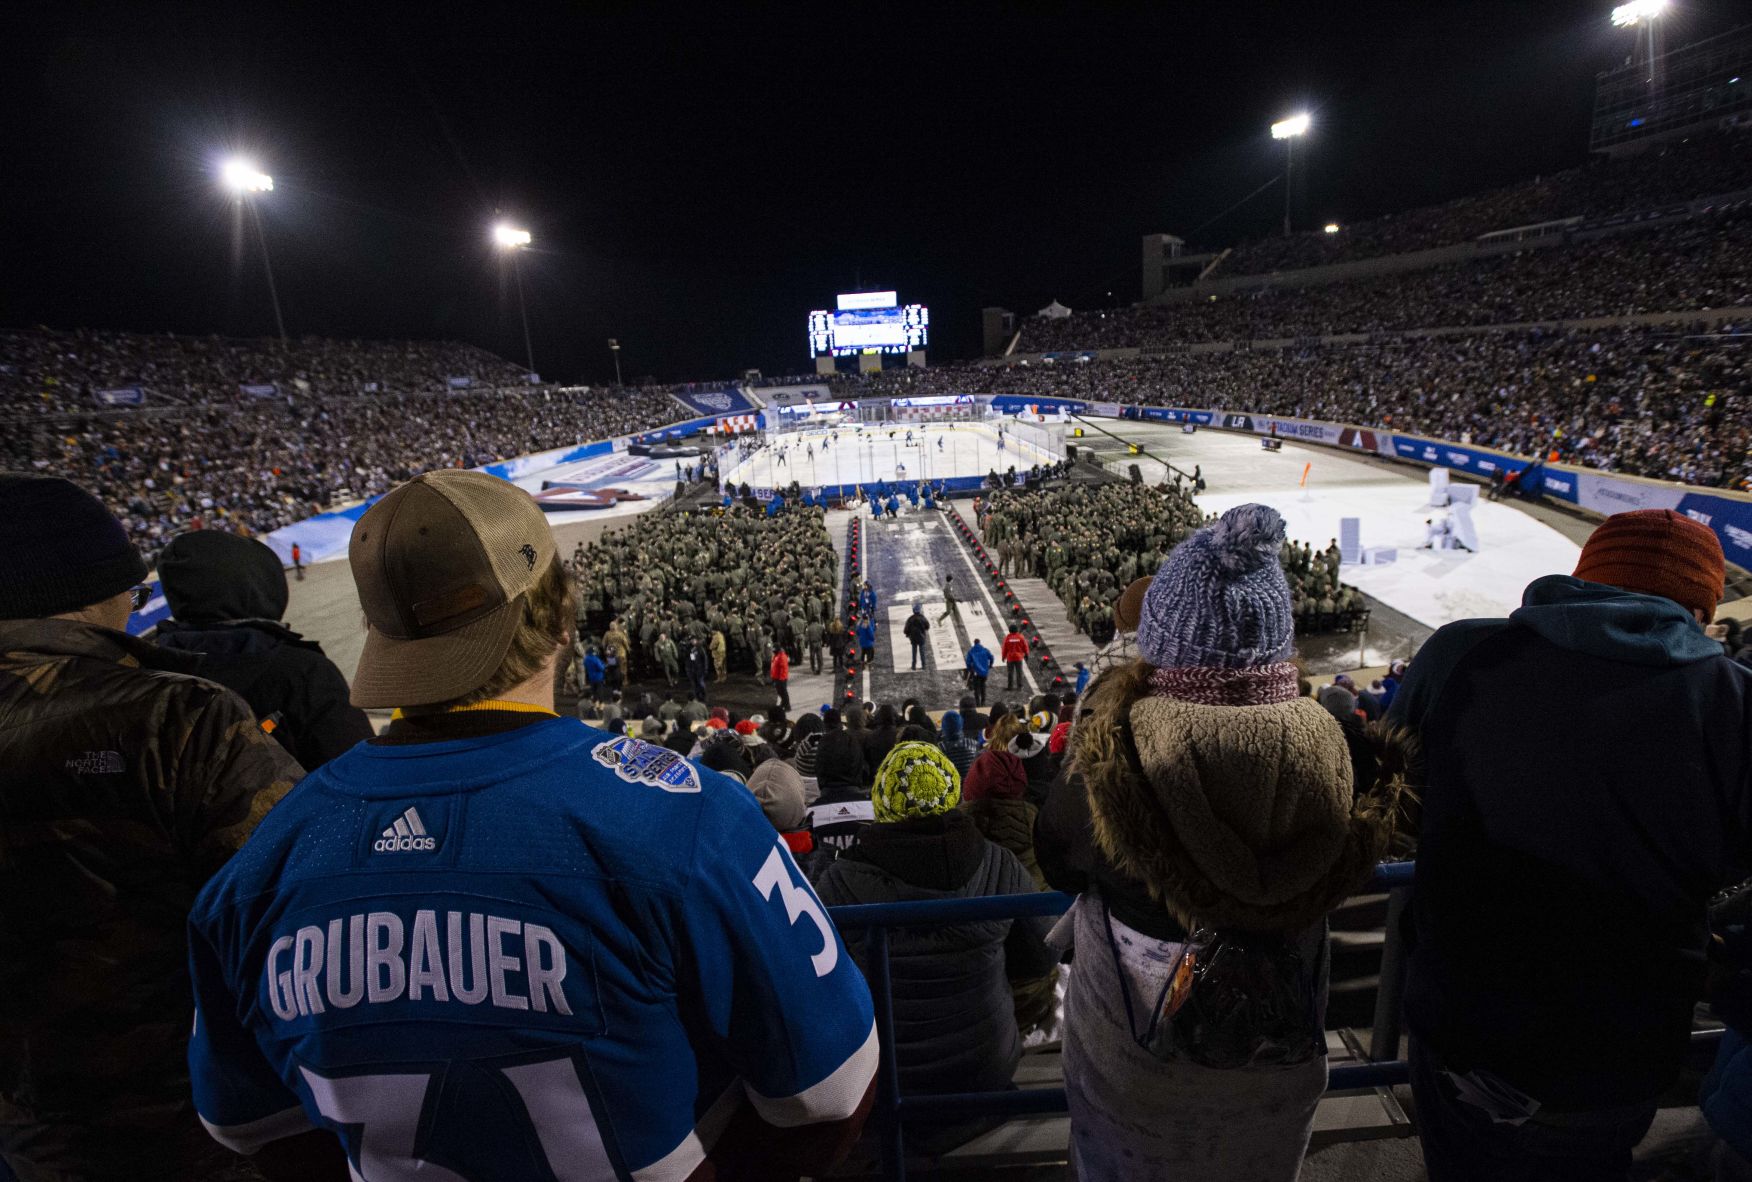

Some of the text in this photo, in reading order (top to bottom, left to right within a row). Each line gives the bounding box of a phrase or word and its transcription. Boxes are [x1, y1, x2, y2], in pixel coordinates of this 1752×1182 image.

[1299, 425, 1324, 439] SERIES
[84, 751, 107, 759] THE
[64, 758, 107, 769] NORTH
[77, 766, 106, 775] FACE
[373, 834, 437, 854] adidas
[824, 835, 861, 850] MAK
[266, 909, 575, 1022] GRUBAUER
